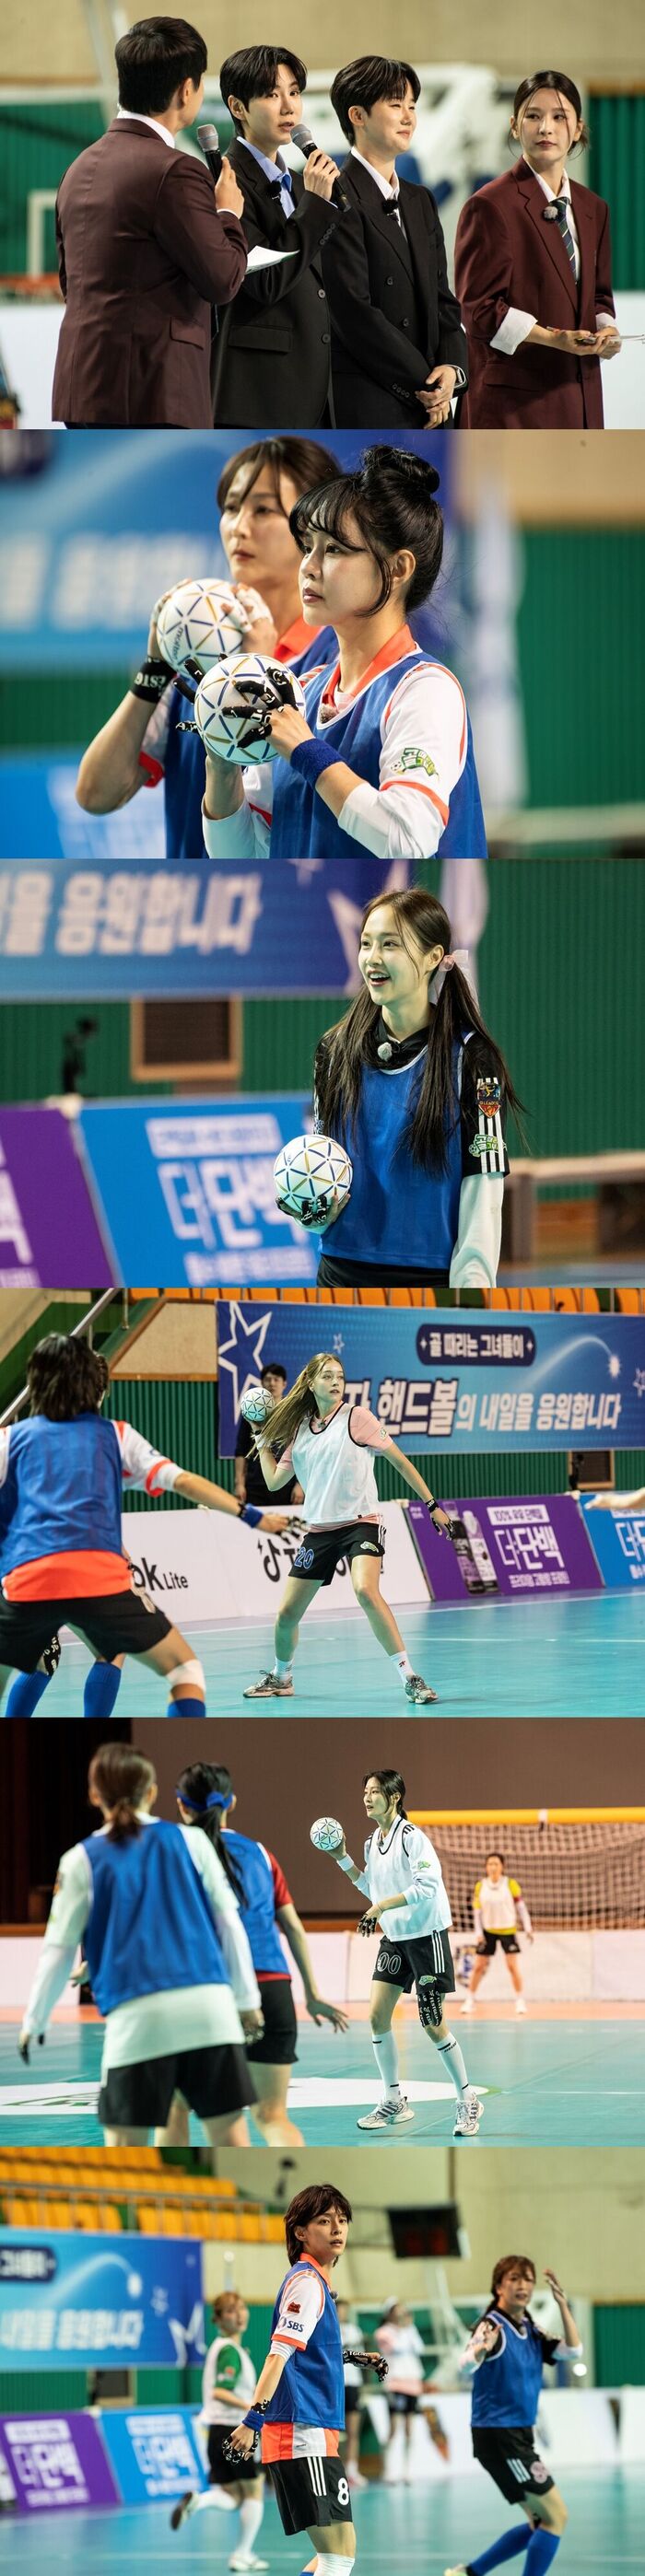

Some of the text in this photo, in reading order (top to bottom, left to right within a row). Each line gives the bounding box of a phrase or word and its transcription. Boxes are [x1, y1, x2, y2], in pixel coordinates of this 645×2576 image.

[55, 870, 263, 956] 응원합니다
[429, 1332, 524, 1358] 골 때리는 그녀들이
[479, 1393, 534, 1431] 내일을
[536, 1393, 622, 1430] 응원합니다
[294, 1546, 314, 1569] 20
[163, 1571, 189, 1590] Lite
[287, 2320, 305, 2333] SBS
[337, 2477, 349, 2505] 8
